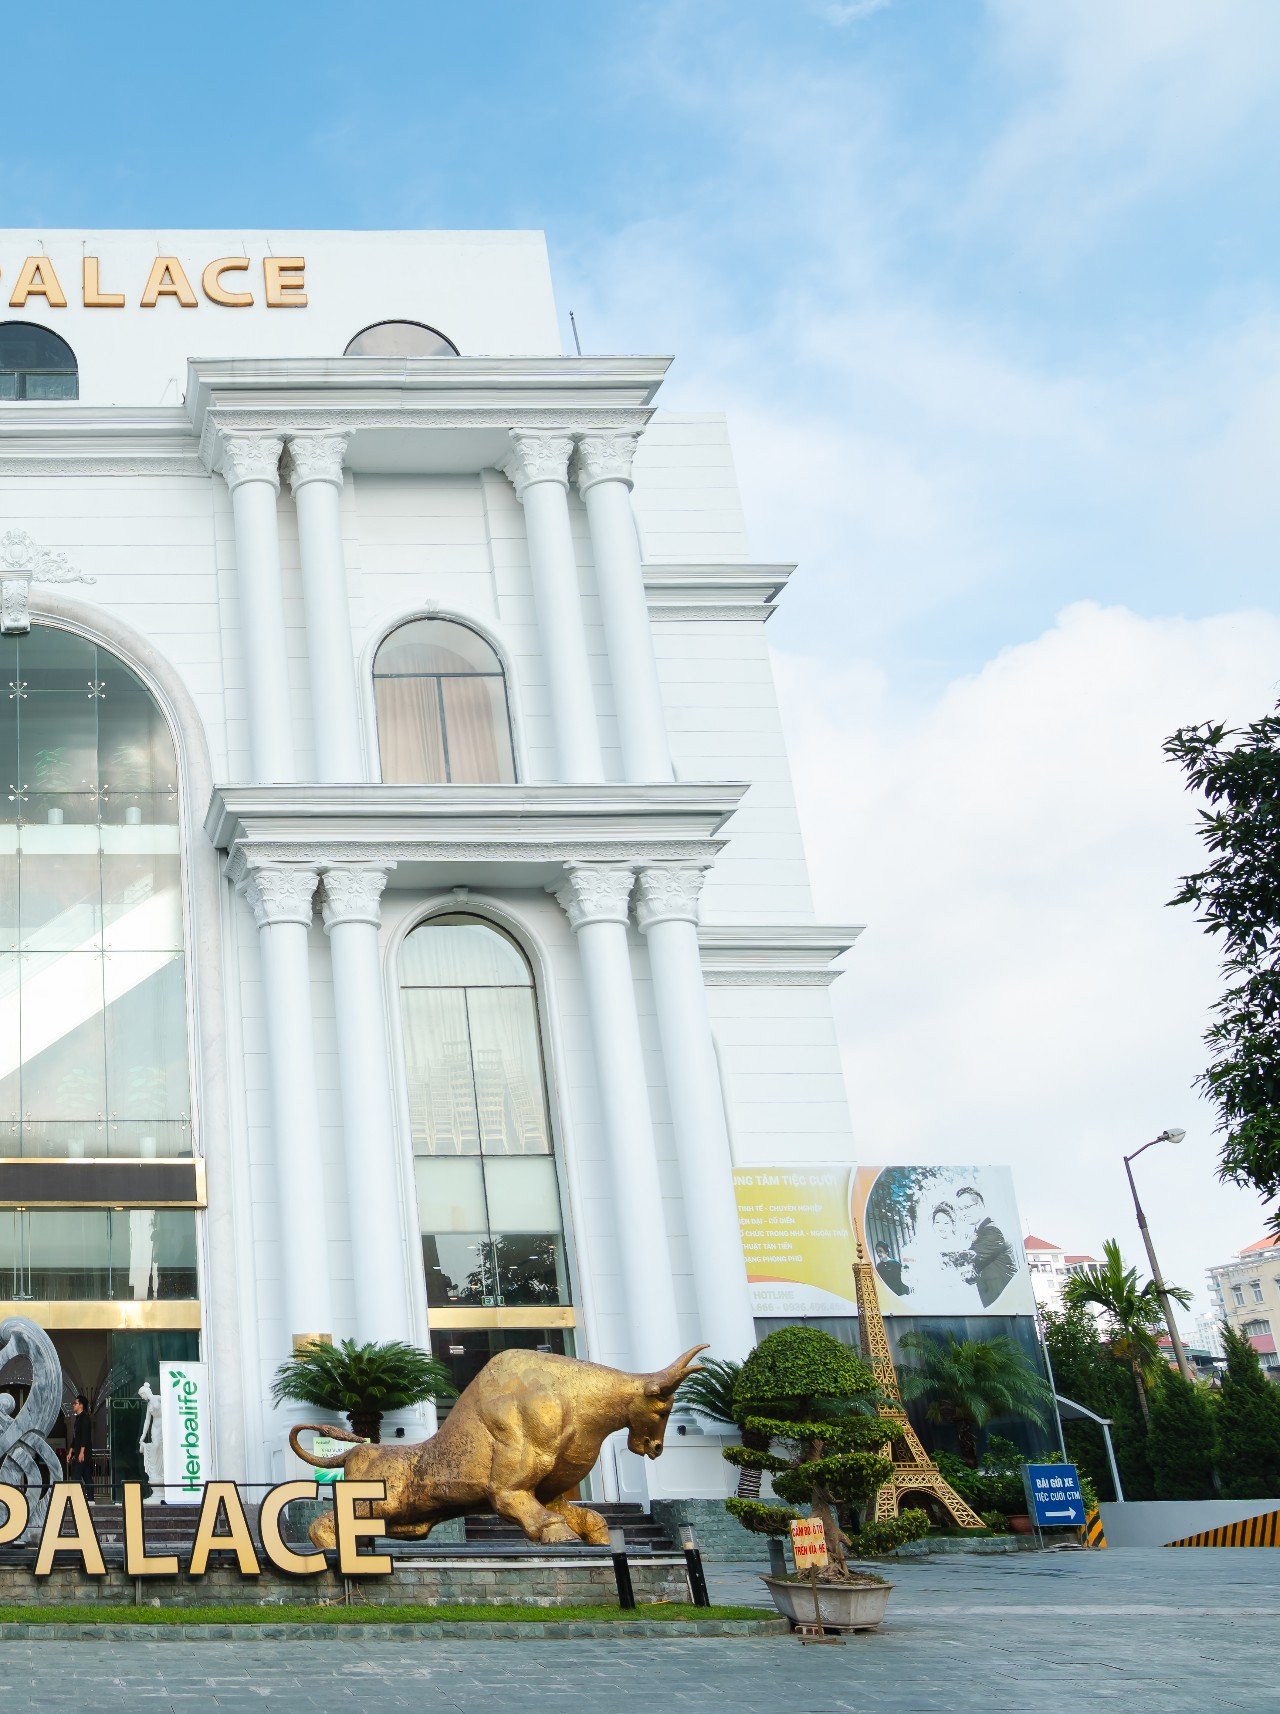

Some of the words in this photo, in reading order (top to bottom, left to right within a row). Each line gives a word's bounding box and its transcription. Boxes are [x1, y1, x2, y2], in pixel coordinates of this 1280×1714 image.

[733, 1175, 752, 1186] UNG
[755, 1174, 779, 1186] TÂM
[782, 1174, 807, 1187] TIỆC
[177, 1380, 202, 1492] Herbalife
[1064, 1478, 1074, 1487] XE
[1067, 1491, 1080, 1500] CTM
